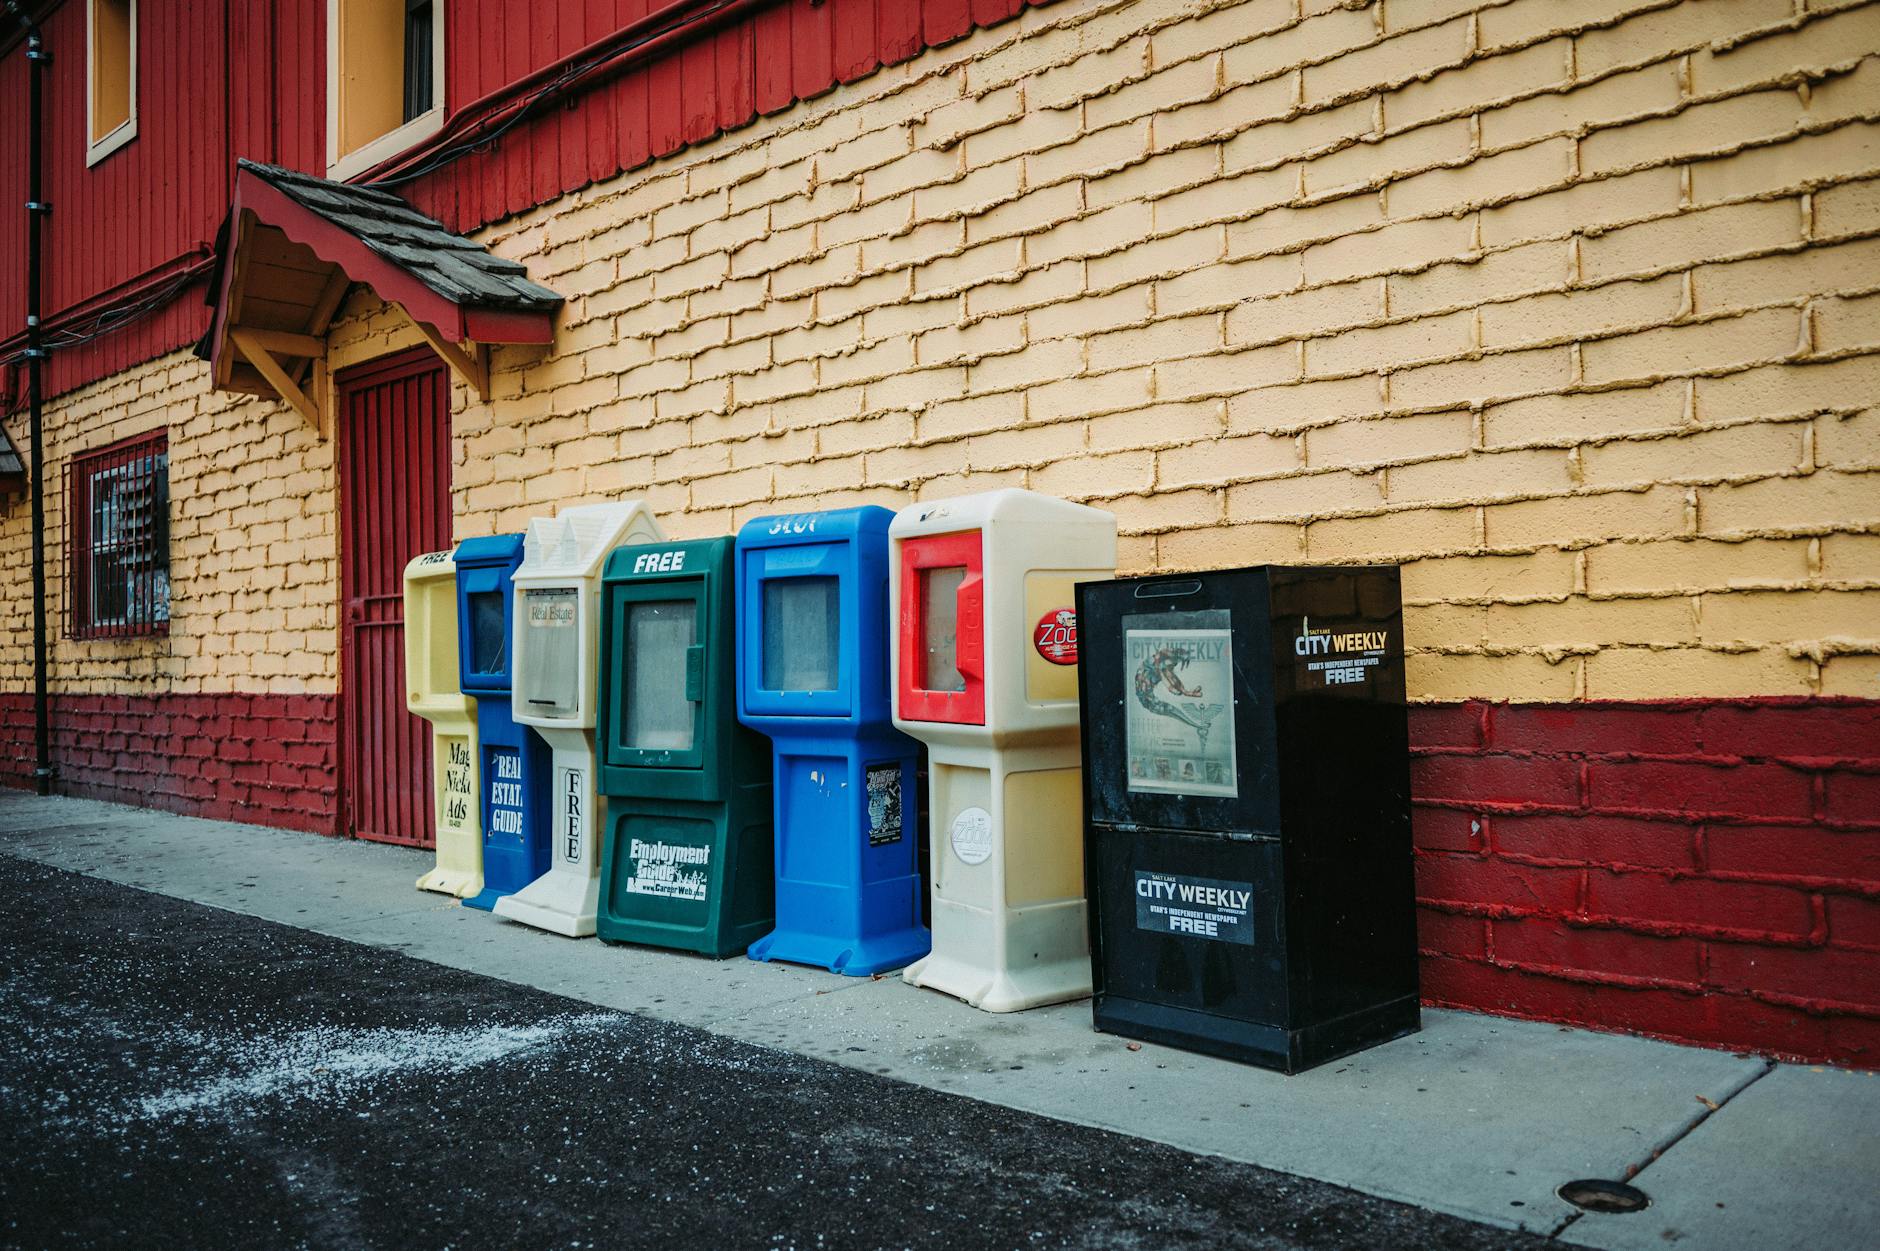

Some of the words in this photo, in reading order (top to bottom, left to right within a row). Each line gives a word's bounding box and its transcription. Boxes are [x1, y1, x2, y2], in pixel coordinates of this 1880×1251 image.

[420, 552, 449, 565] FREE
[633, 551, 685, 573] FREE
[532, 606, 547, 620] Real
[550, 607, 573, 620] Estate
[1039, 623, 1077, 646] Zoo
[1296, 632, 1331, 655] CITY
[1333, 632, 1387, 653] WEEKLY
[1133, 641, 1161, 660] CITY
[1166, 640, 1225, 661] WEEKLY
[1325, 667, 1365, 685] FREE
[446, 770, 470, 794] Nick
[491, 781, 523, 807] ESTAT
[446, 798, 467, 820] Ads
[567, 771, 580, 860] FREE
[492, 809, 523, 835] GUIDE
[629, 839, 711, 865] Employment
[637, 859, 675, 881] Guide
[1137, 879, 1176, 900] CITY
[1179, 884, 1250, 909] WEEKLY
[1150, 905, 1168, 914] UTAH'S
[1169, 908, 1204, 919] INDEPENDENT
[1204, 912, 1238, 924] NEWSPAPER
[1170, 916, 1218, 936] FREE
